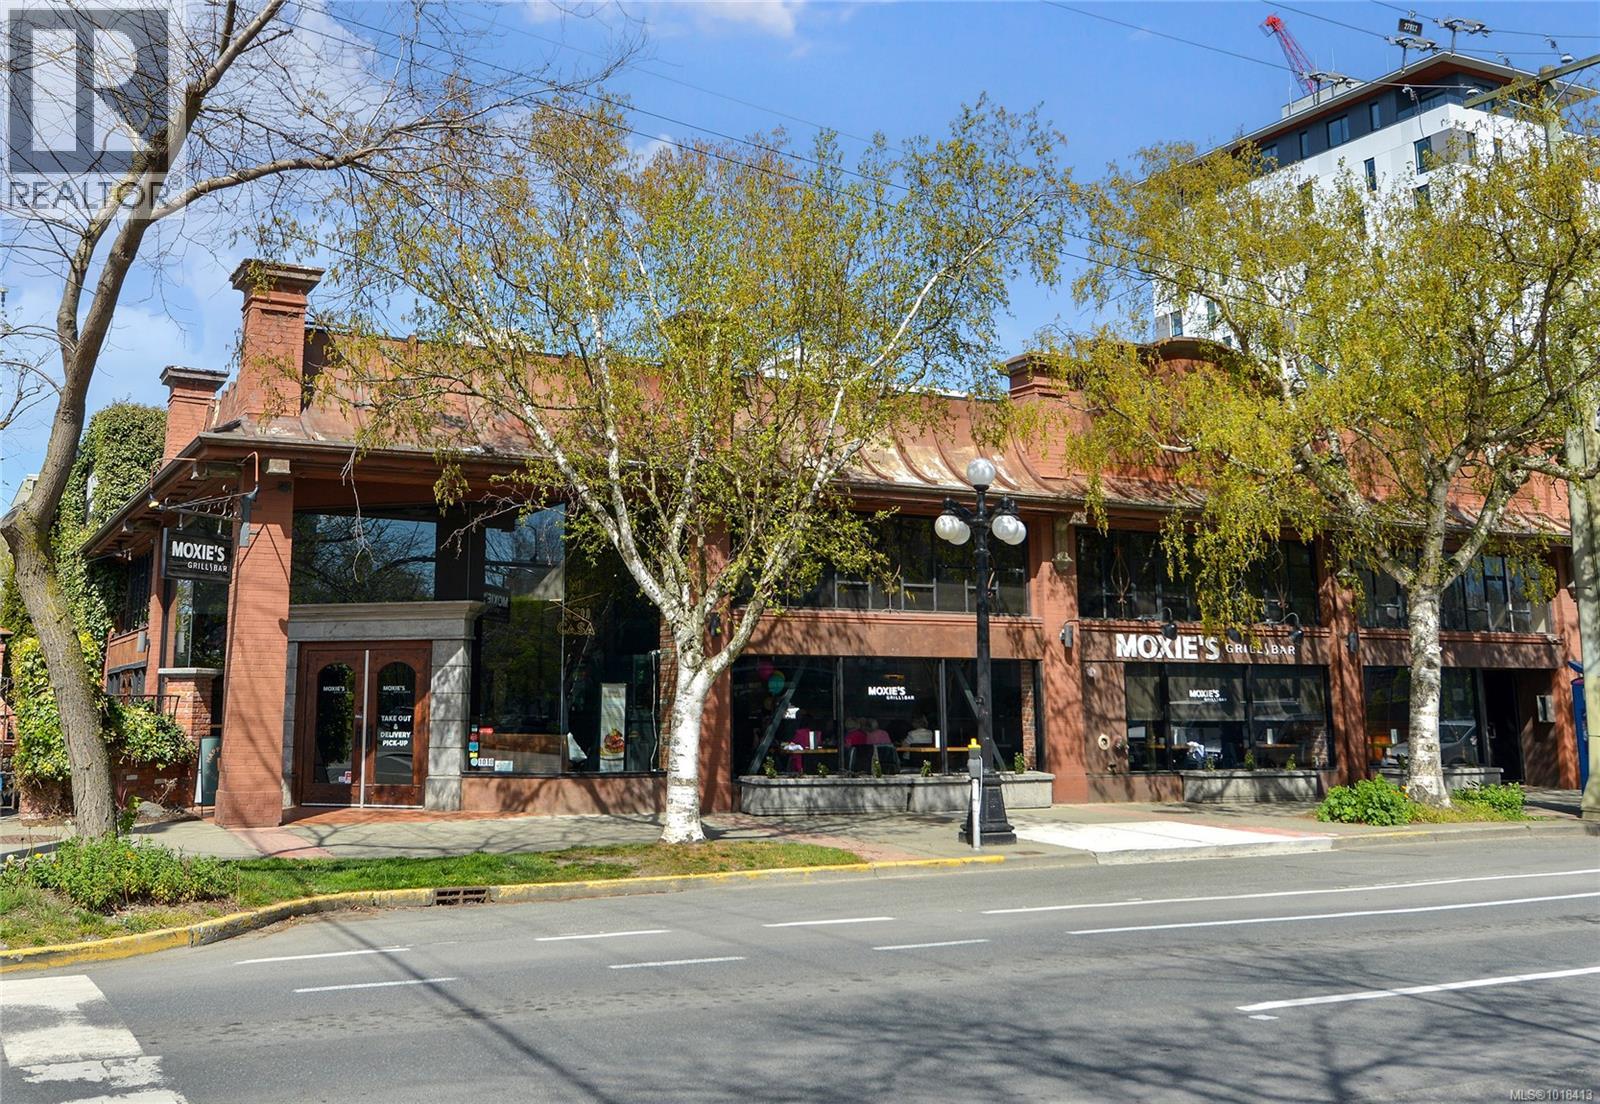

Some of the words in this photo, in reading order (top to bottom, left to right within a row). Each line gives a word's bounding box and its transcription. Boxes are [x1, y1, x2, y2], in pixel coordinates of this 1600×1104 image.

[171, 540, 226, 562] MOXIE'S
[1115, 633, 1221, 661] MOXIE'S
[1271, 643, 1297, 656] BAR
[868, 686, 906, 696] MOXIE'S
[1189, 689, 1220, 698] MOXIE'S
